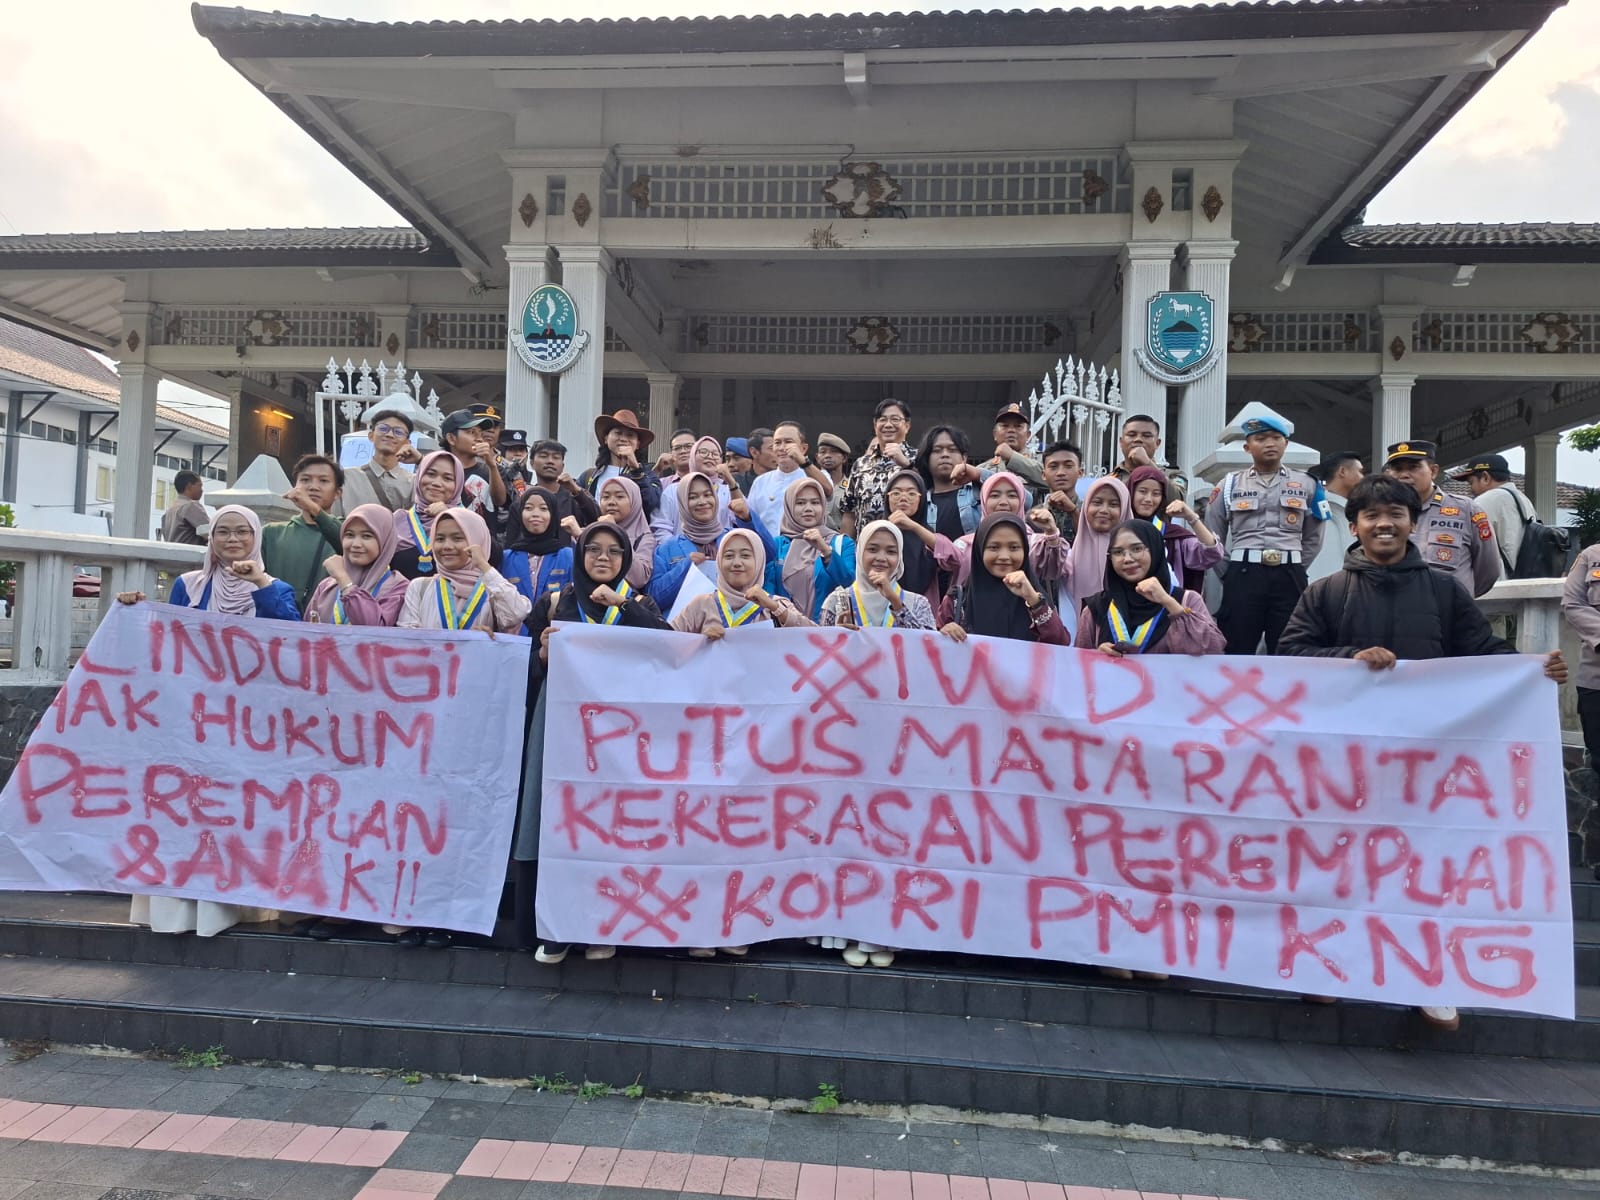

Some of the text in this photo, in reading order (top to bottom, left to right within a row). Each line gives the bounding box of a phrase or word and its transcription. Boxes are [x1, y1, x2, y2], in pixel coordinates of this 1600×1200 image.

[1430, 520, 1465, 530] POLRI
[192, 693, 435, 775] HUKUM
[579, 703, 1535, 822] PUTUS MATA RANTAI
[18, 743, 447, 856] PEREMPUAN
[555, 782, 1042, 866] KEKERASAN
[720, 867, 1537, 998] KOPRI PMII KNG
